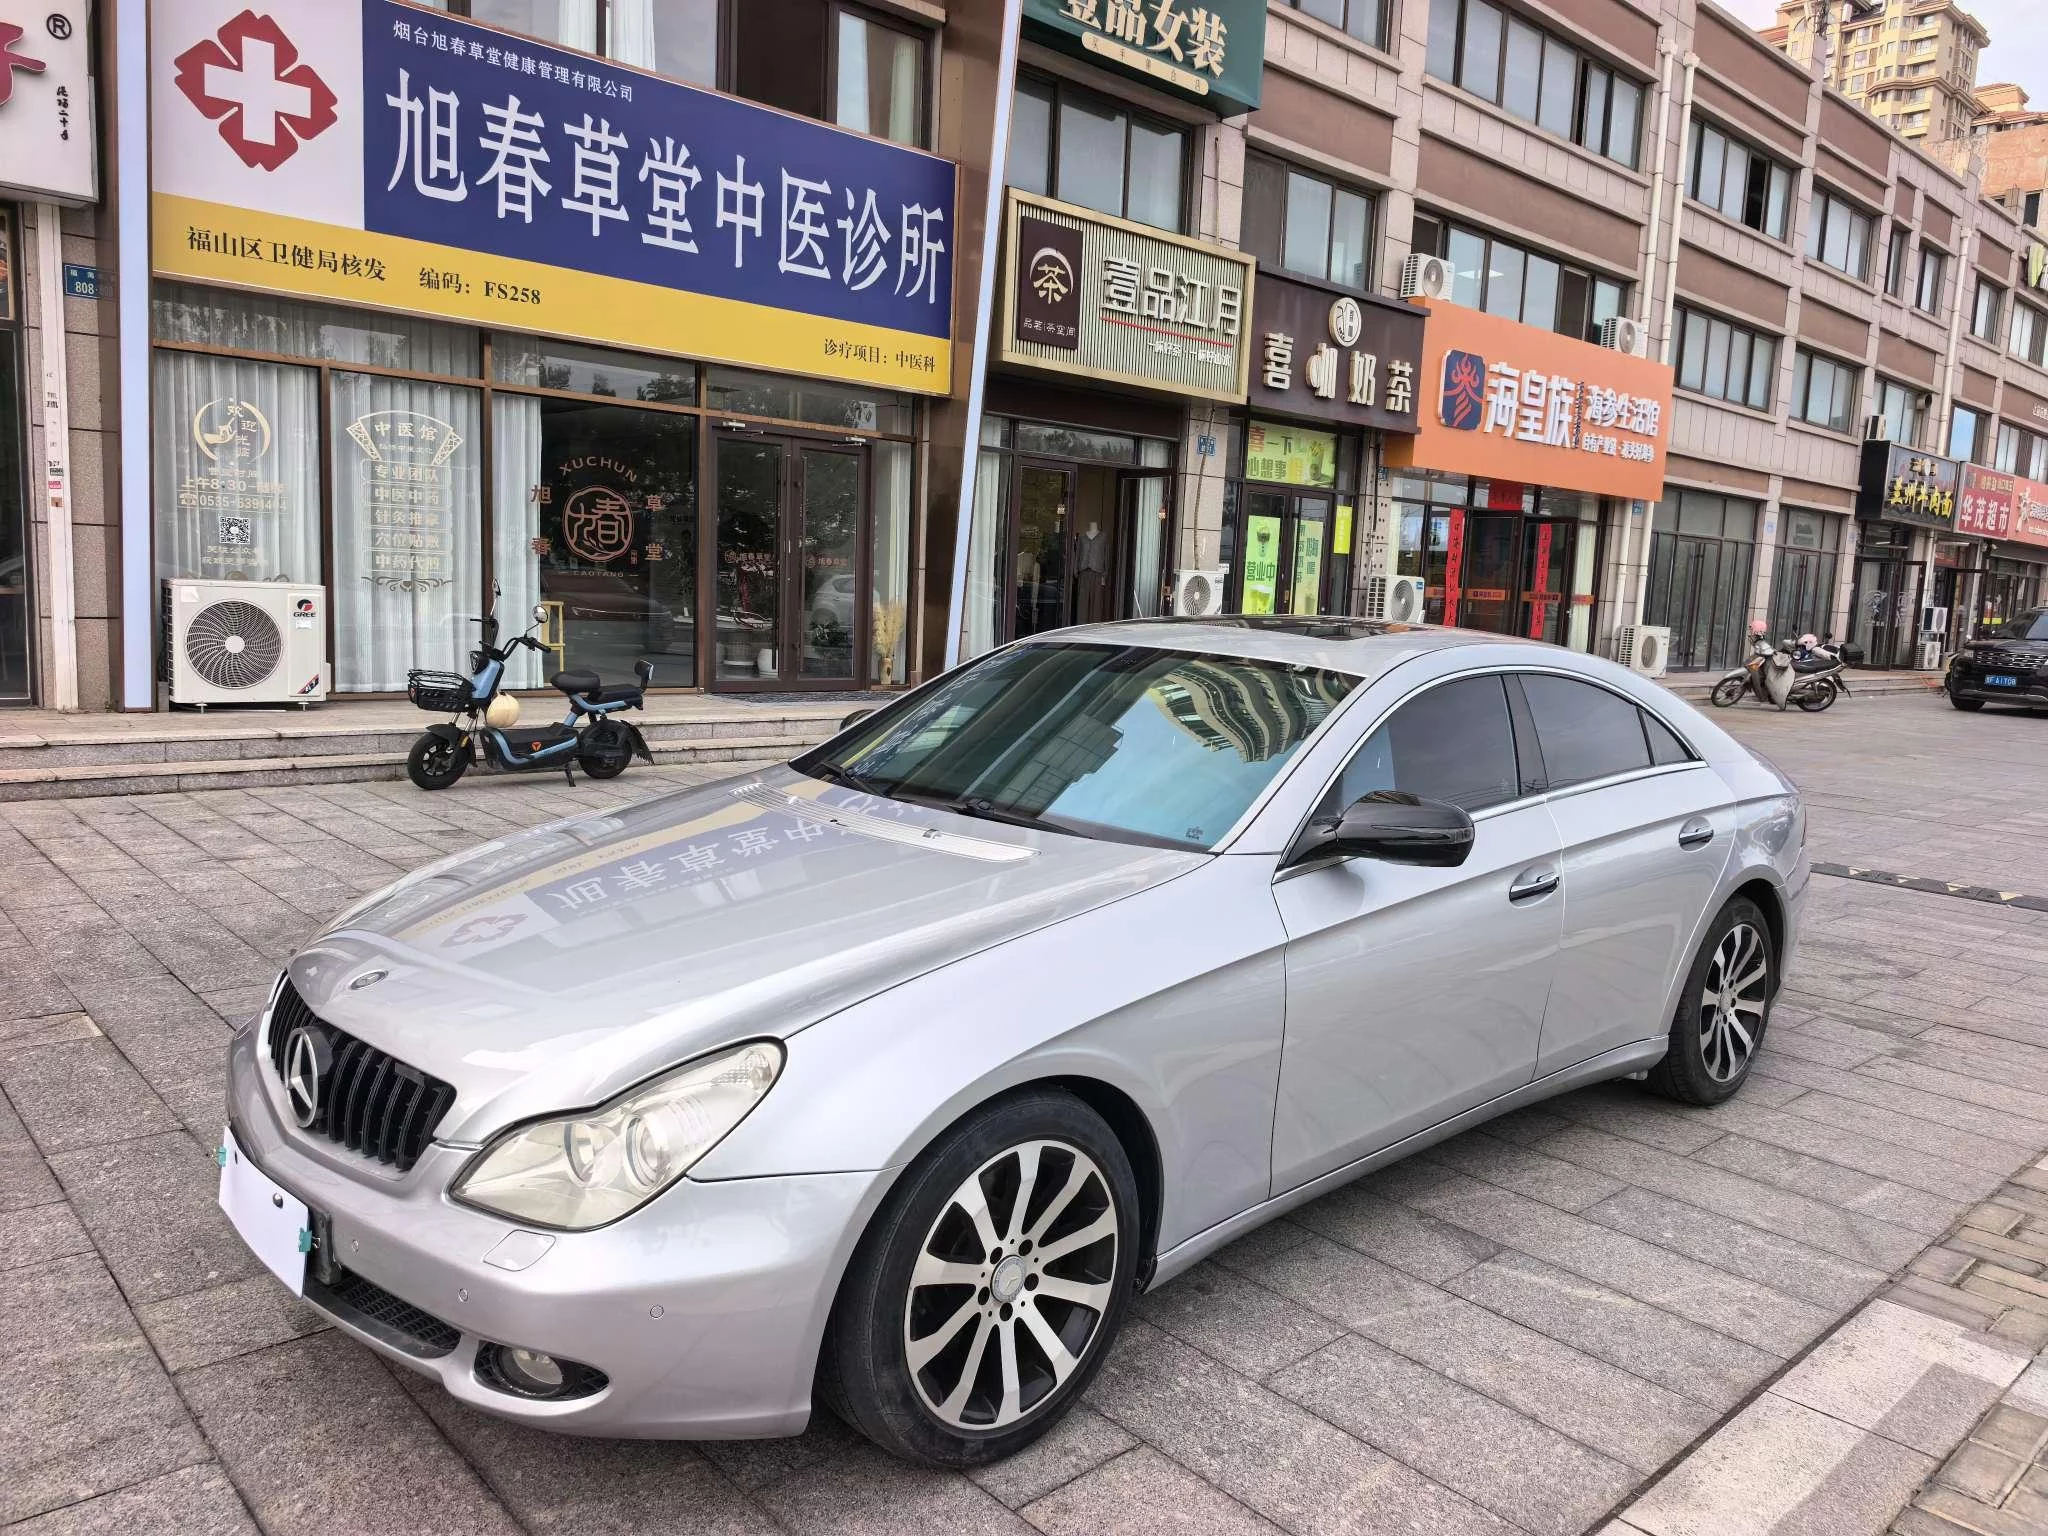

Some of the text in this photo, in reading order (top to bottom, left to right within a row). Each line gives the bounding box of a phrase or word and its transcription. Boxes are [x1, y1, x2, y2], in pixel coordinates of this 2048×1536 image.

[393, 20, 633, 102] 烟台旭春草堂健康管理有限公司
[386, 68, 946, 304] 旭春草堂中医诊所
[187, 225, 387, 281] 福山区卫健局核发
[1034, 263, 1069, 304] 茶
[1101, 256, 1241, 336] 壹品江月
[375, 421, 437, 441] 中医馆
[375, 464, 438, 483] 专业团队
[560, 456, 638, 483] XUCHUN
